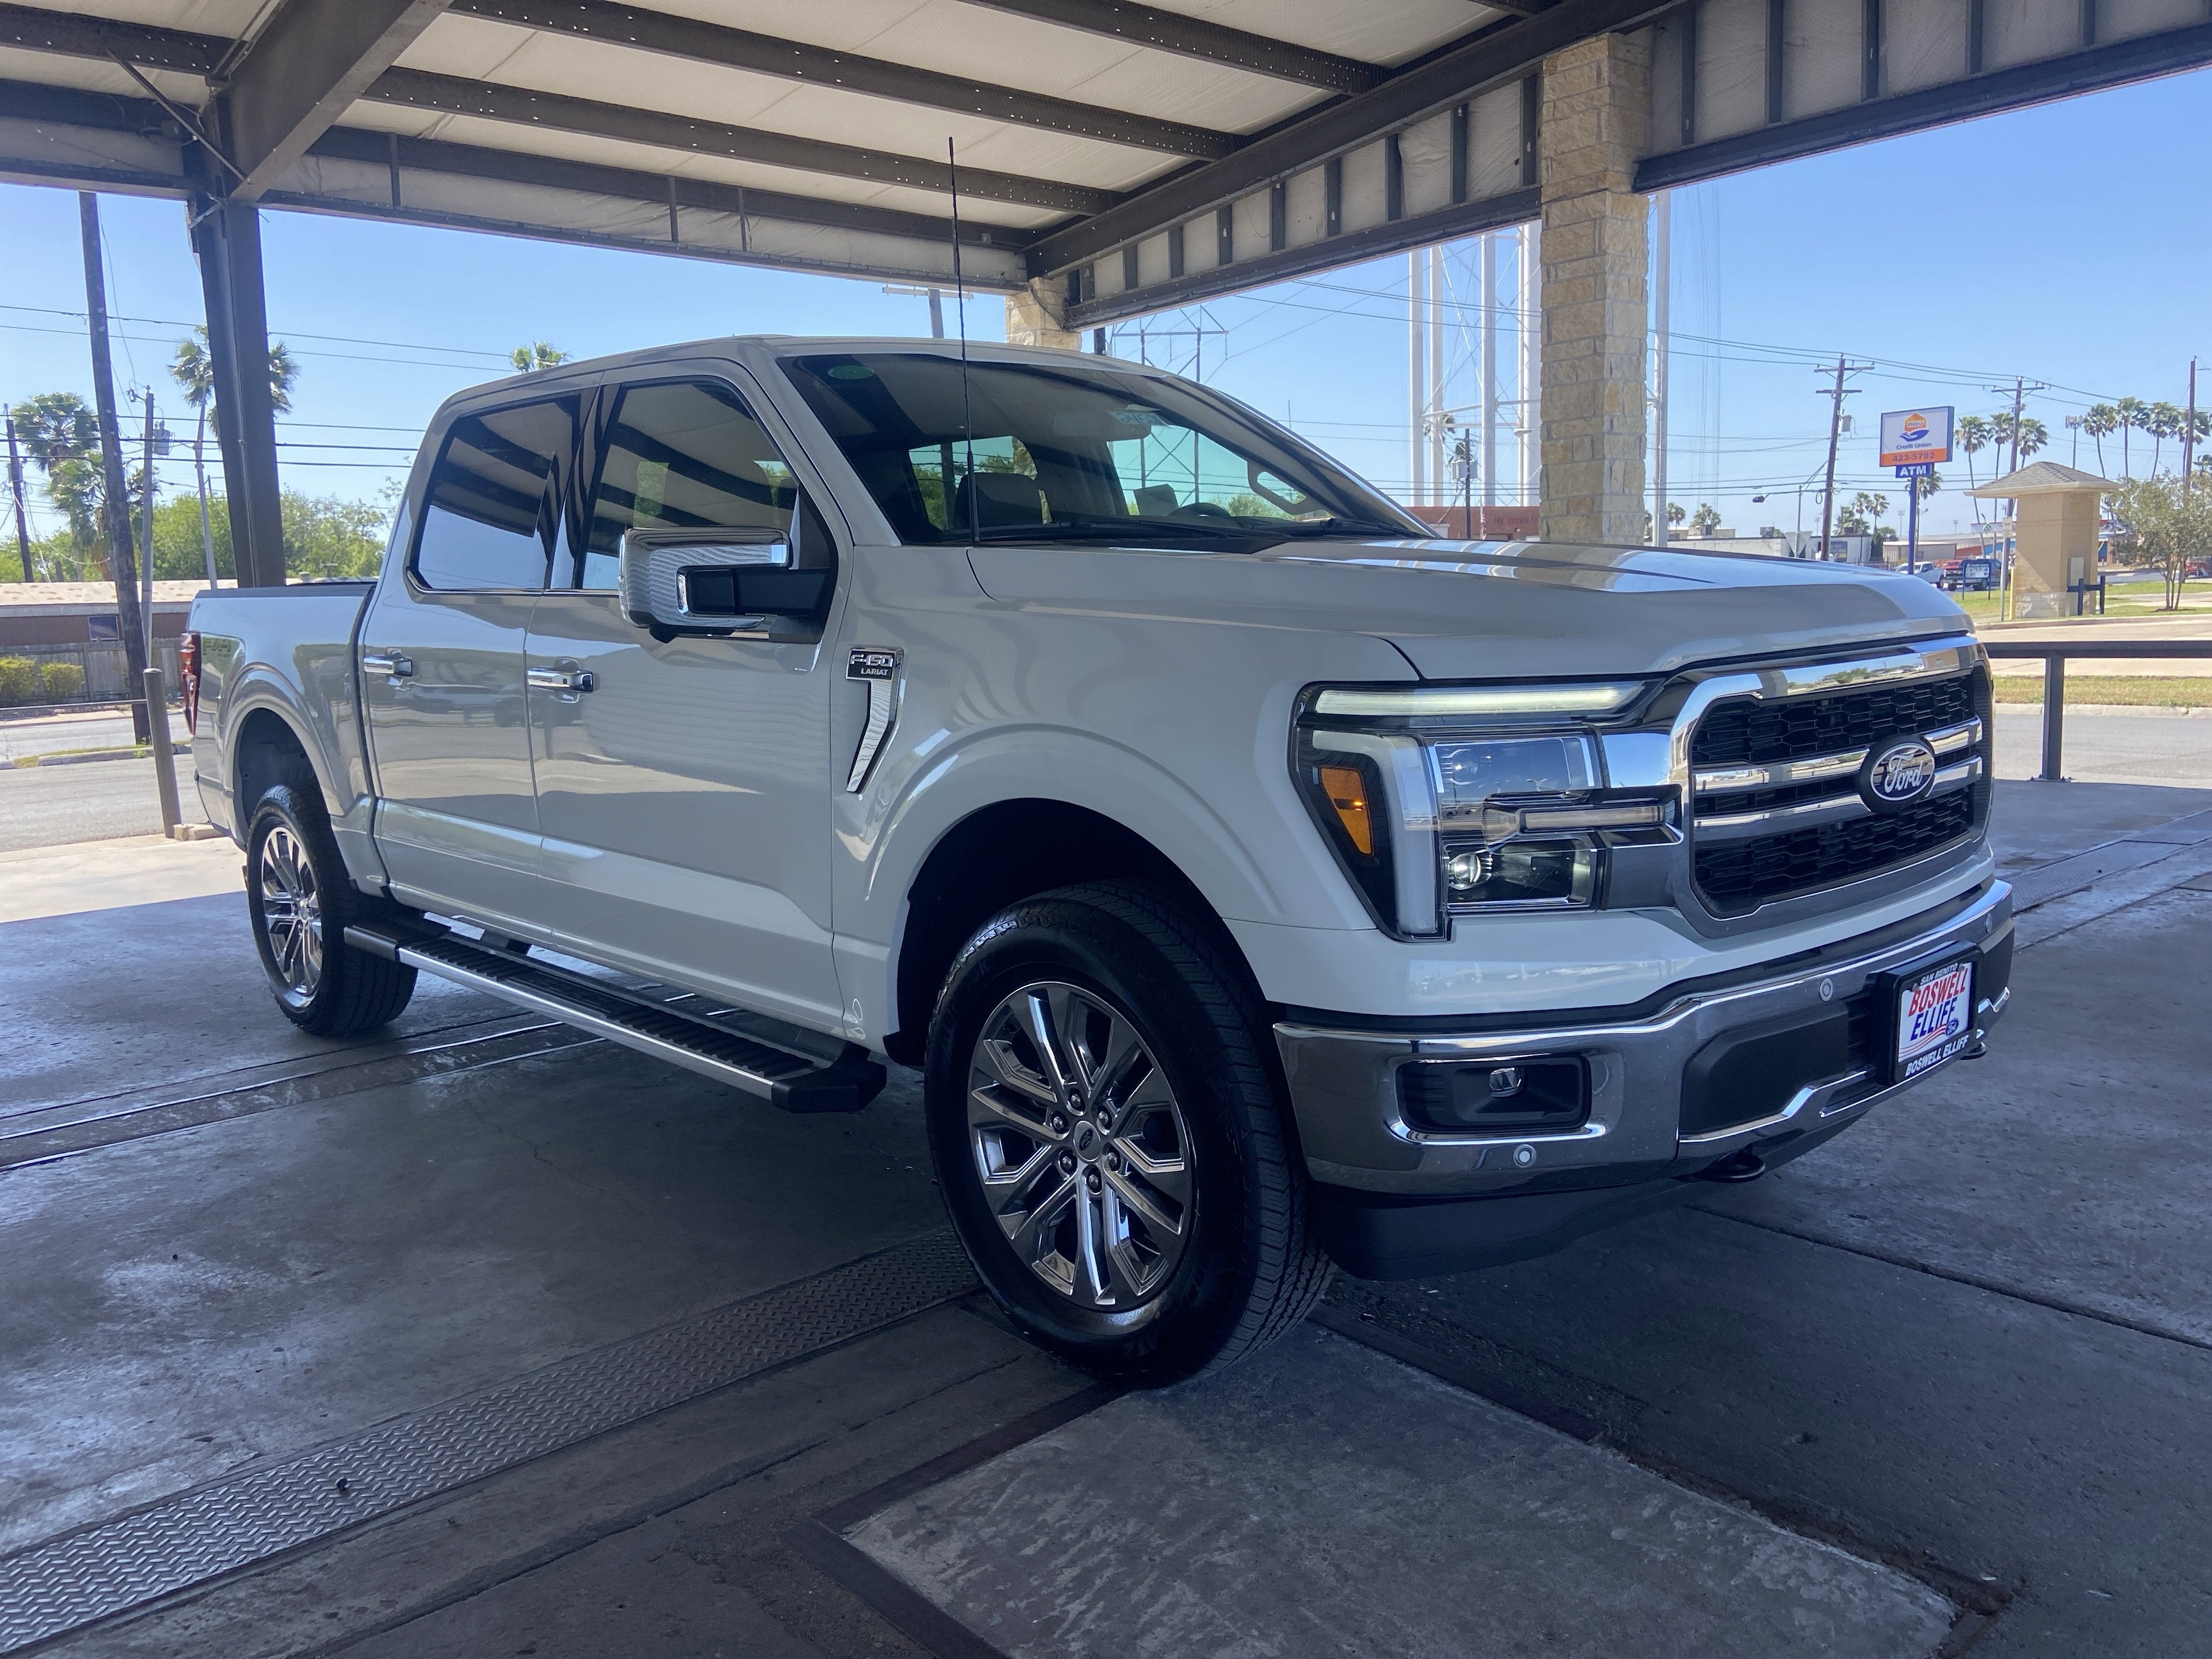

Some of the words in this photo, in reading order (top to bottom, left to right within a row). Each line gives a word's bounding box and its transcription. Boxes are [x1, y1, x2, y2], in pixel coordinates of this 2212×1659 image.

[1900, 465, 1926, 476] ATM
[850, 654, 894, 667] F-150
[1884, 754, 1923, 793] Ford
[1908, 968, 1968, 1017] BOSWELL
[1920, 973, 1934, 985] SAN
[1934, 963, 1957, 979] BENITO
[1910, 997, 1957, 1041] ELLIFF
[1905, 1048, 1942, 1077] BOSWELL
[1943, 1035, 1969, 1058] ELLIFF
